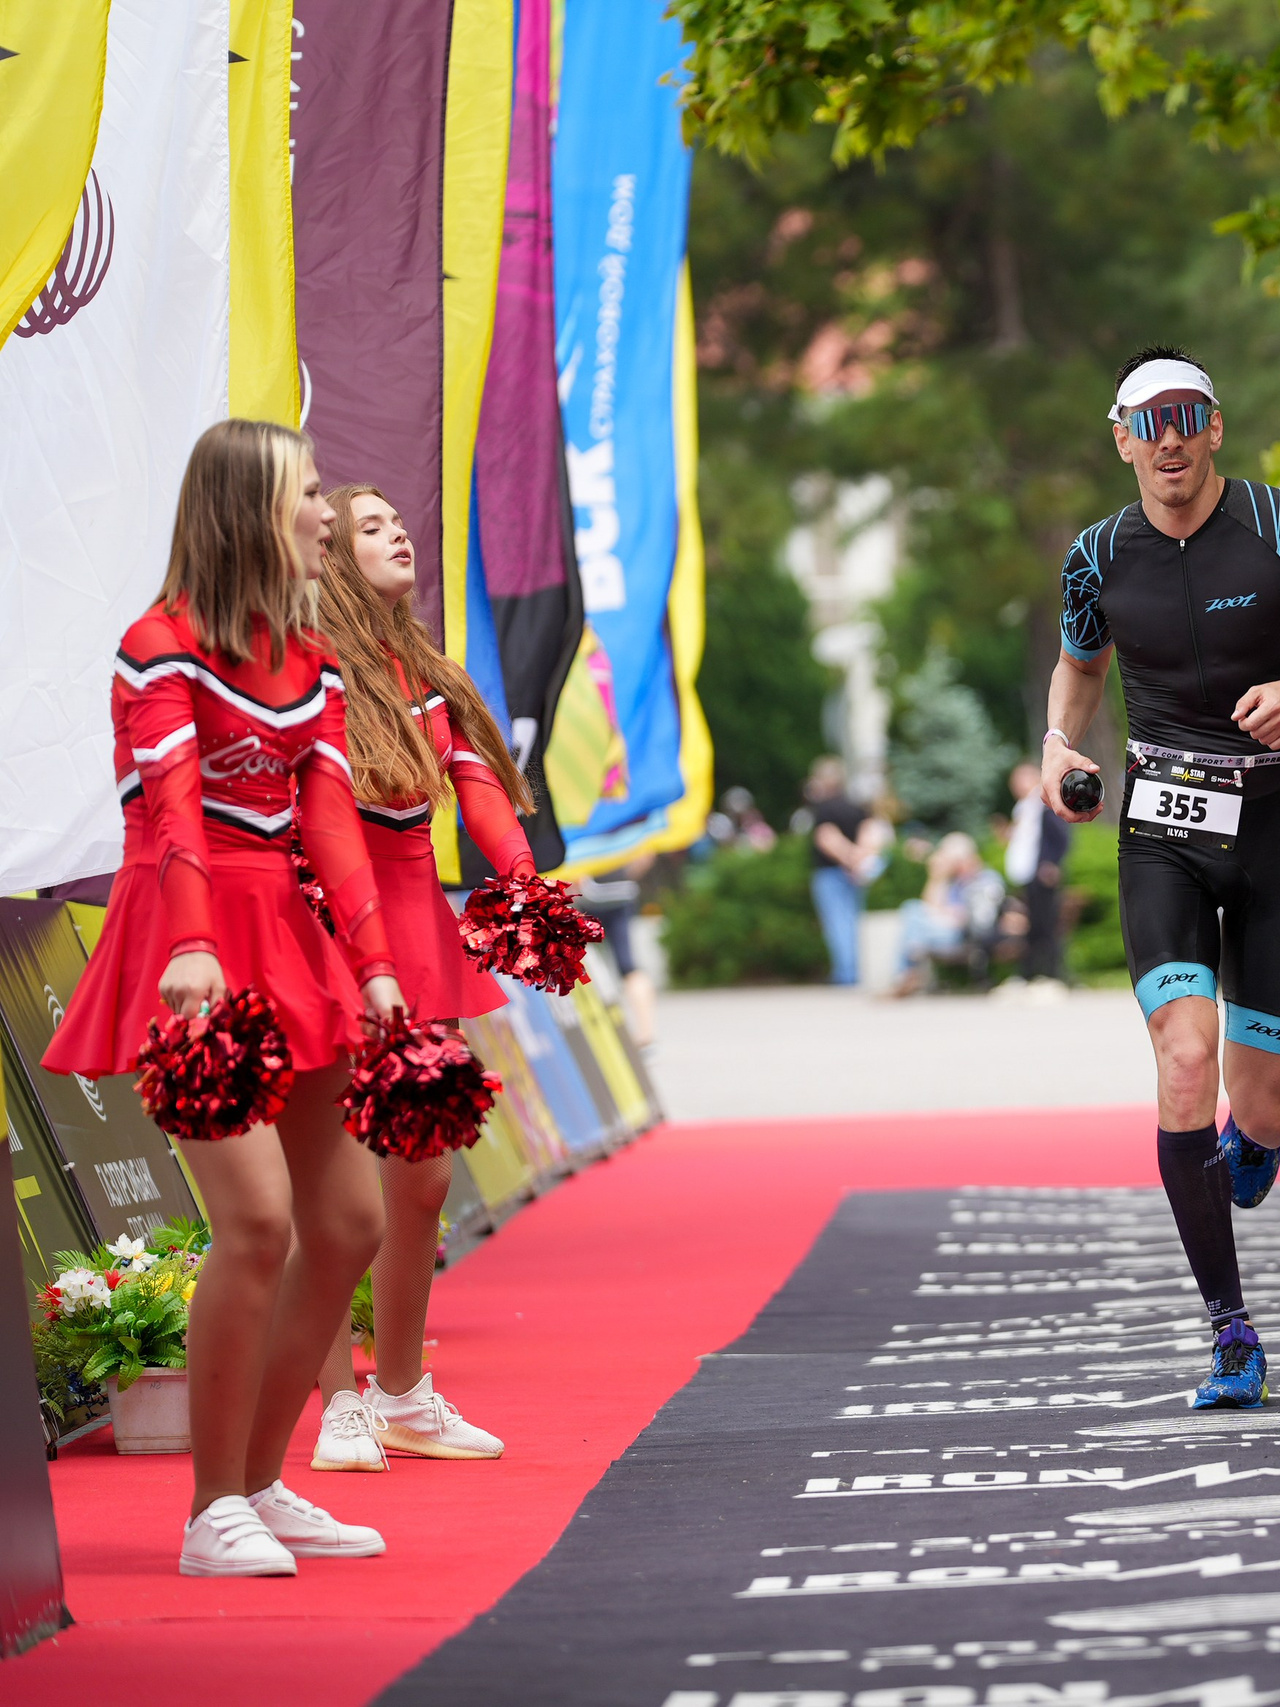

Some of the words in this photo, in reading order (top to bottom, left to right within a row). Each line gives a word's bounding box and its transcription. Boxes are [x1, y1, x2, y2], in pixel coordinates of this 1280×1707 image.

[566, 440, 627, 612] ВСК
[1161, 751, 1224, 766] COMPSSPORT
[1171, 765, 1185, 775] IRON
[1189, 768, 1206, 779] STAR
[1156, 790, 1208, 823] 355
[1166, 827, 1189, 839] ILYAS
[840, 1391, 1127, 1416] IRON
[804, 1466, 1125, 1493] IRON
[743, 1559, 1121, 1594] IRON
[662, 1679, 1109, 1707] IRON
